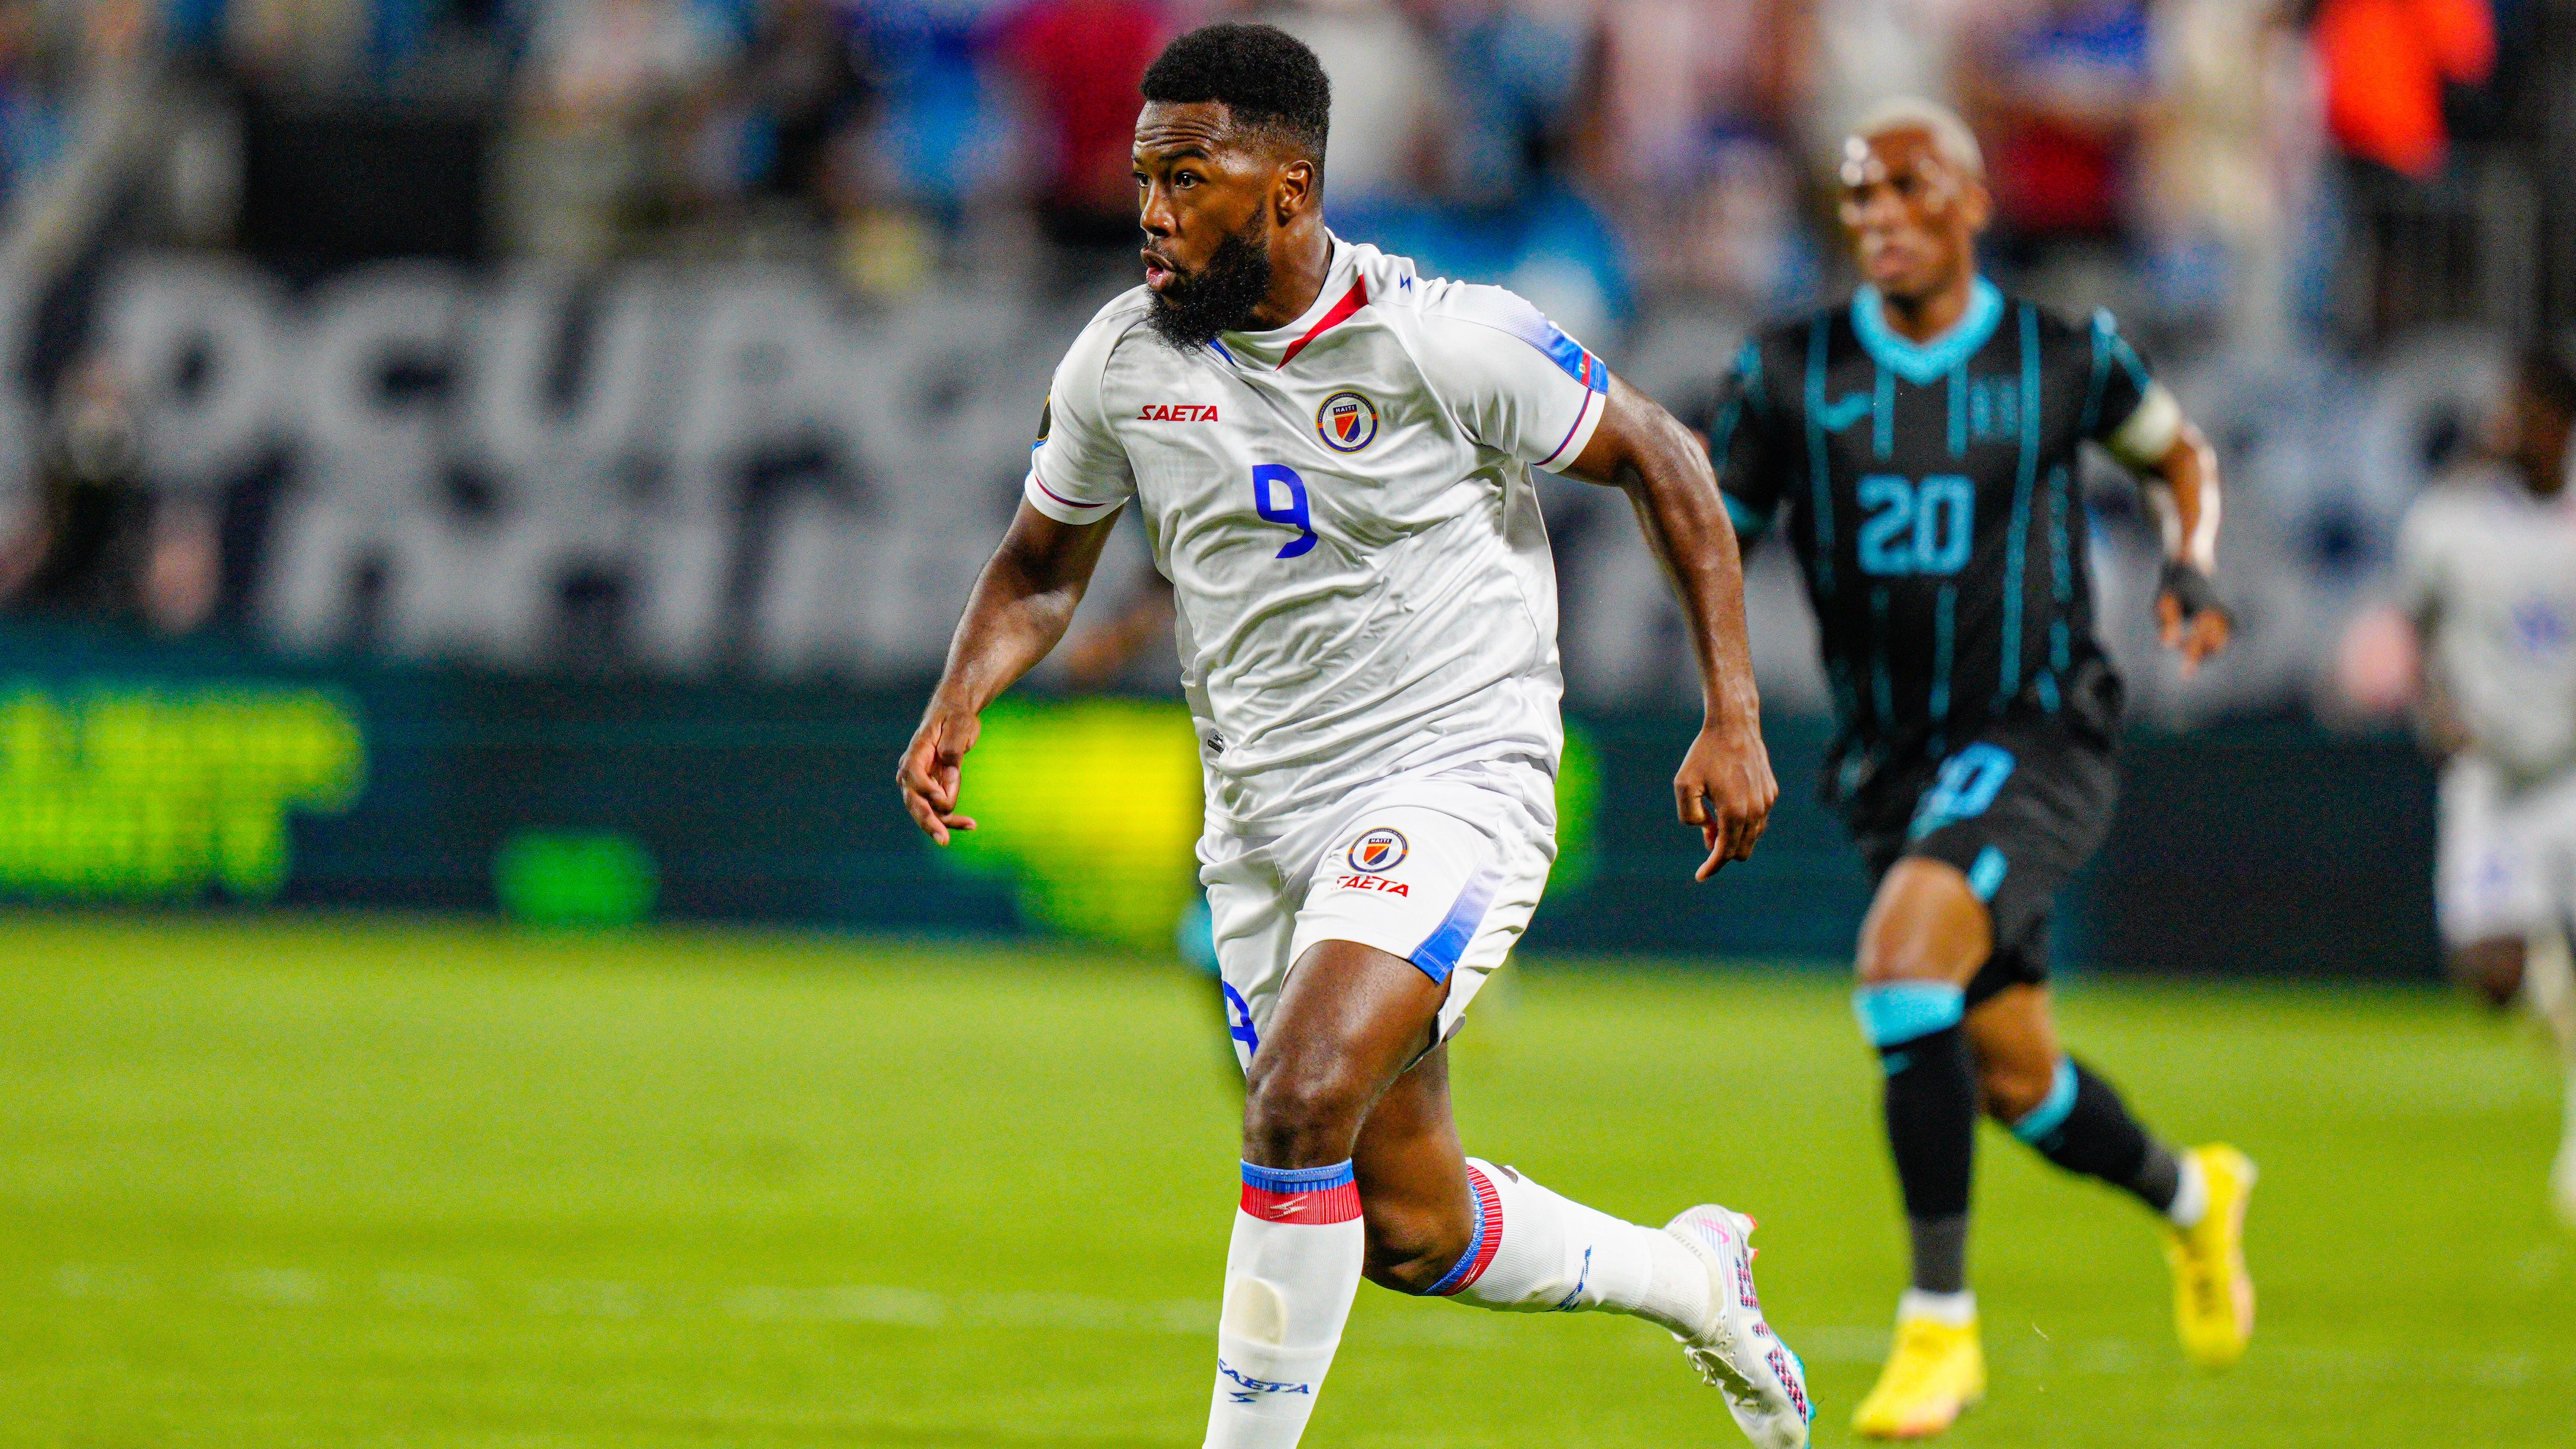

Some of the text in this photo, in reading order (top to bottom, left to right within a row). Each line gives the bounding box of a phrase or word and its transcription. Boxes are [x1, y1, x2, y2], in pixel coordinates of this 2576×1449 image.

[1136, 404, 1218, 422] SAETA
[1252, 464, 1318, 559] 9
[1856, 474, 1976, 575] 20
